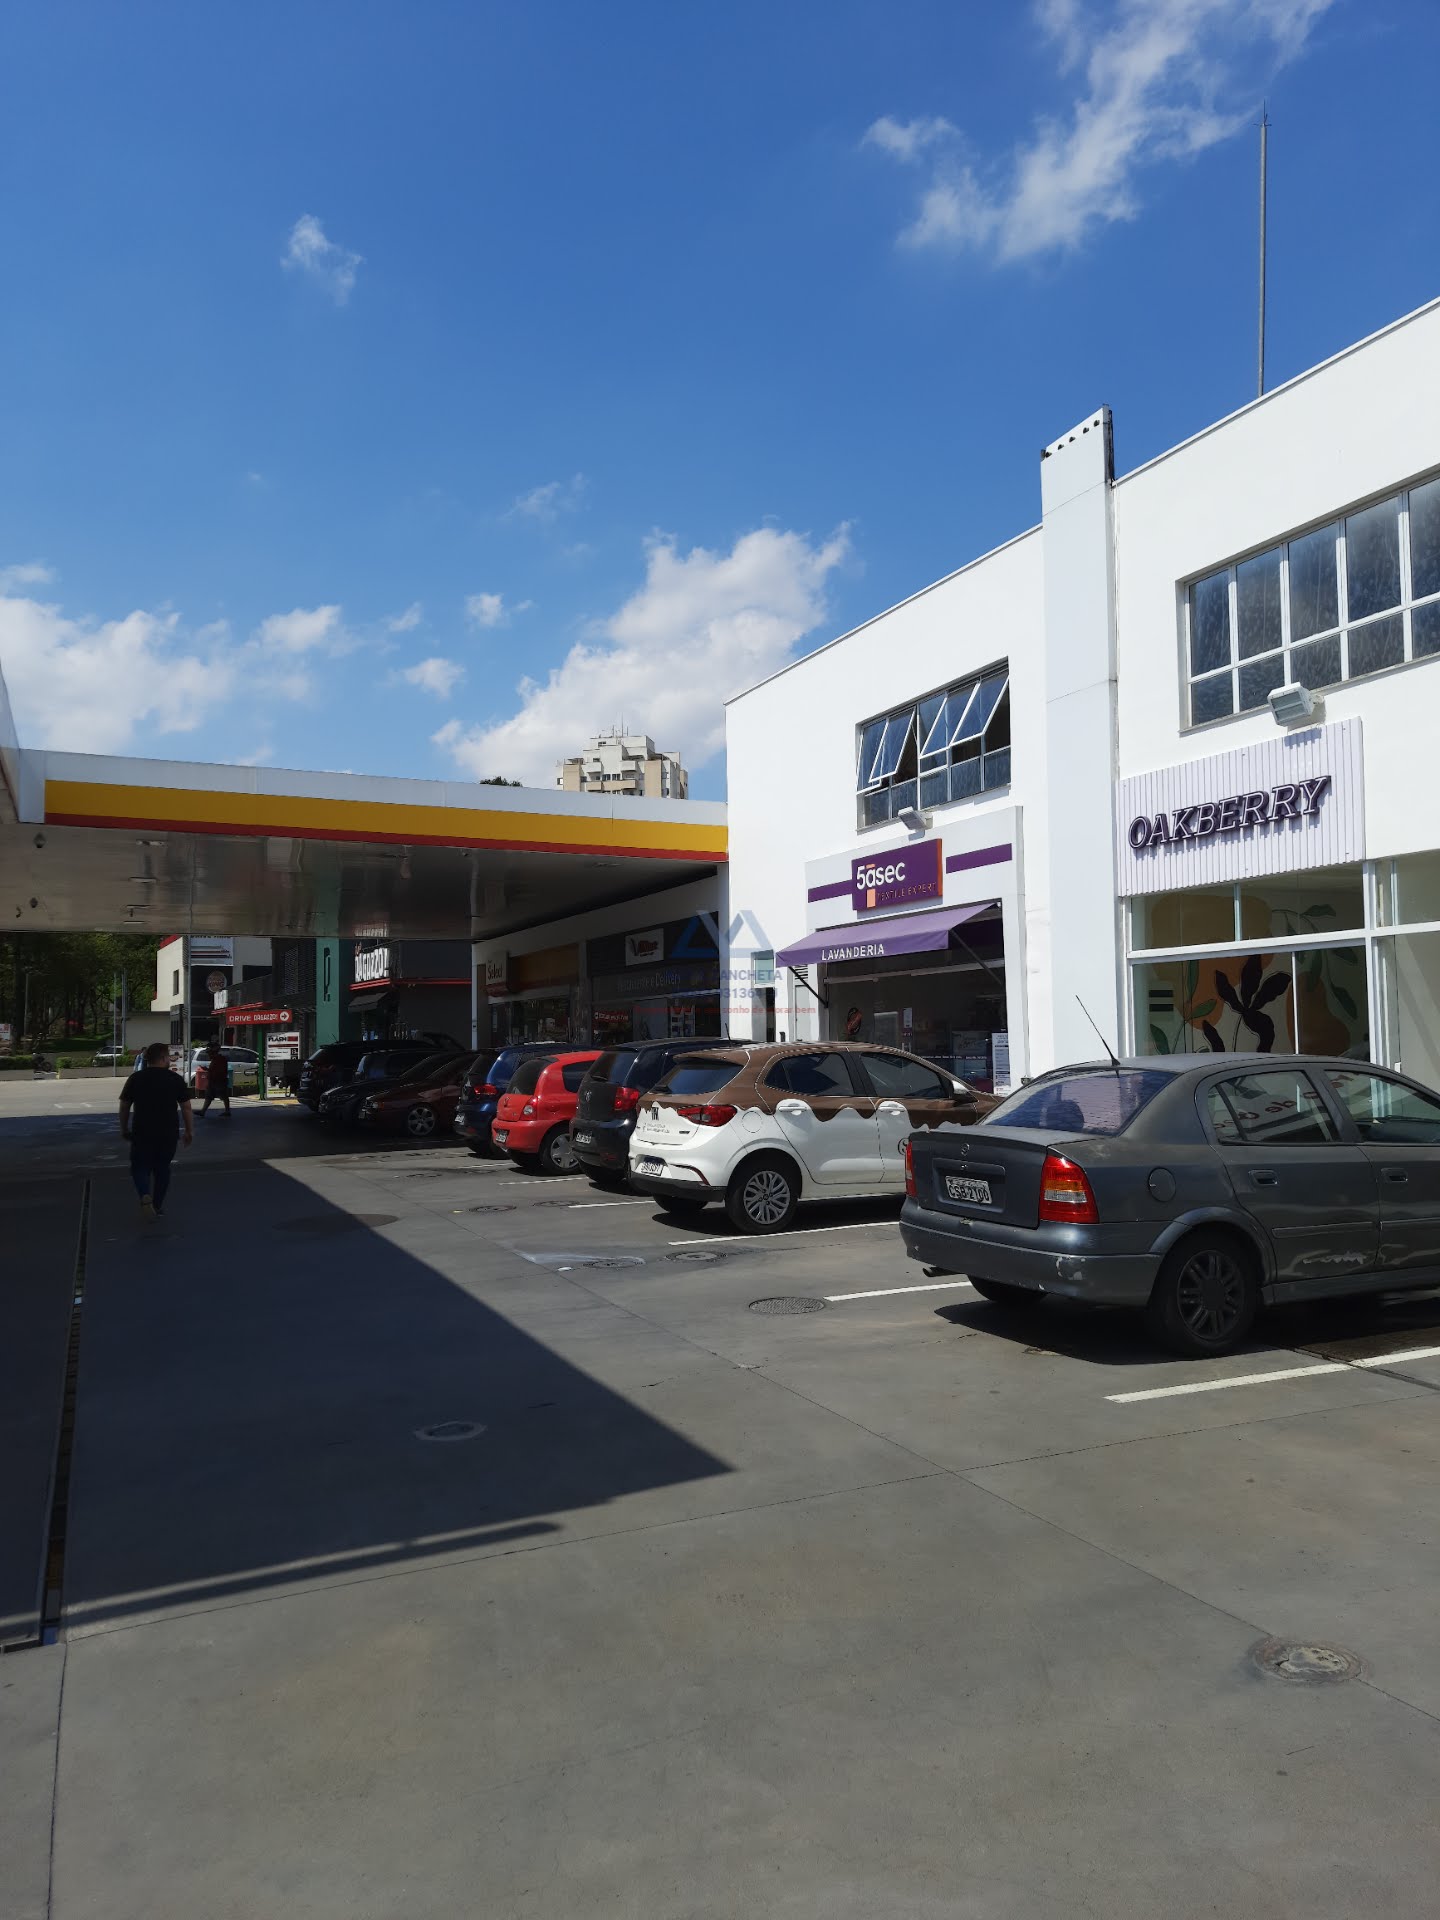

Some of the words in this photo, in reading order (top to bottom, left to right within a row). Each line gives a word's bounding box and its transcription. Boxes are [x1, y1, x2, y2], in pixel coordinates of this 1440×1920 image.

[1128, 775, 1331, 849] OAKBERRY
[908, 882, 937, 897] EXPERT
[821, 943, 885, 961] LAVANDERIA
[229, 1014, 251, 1022] DRIVE
